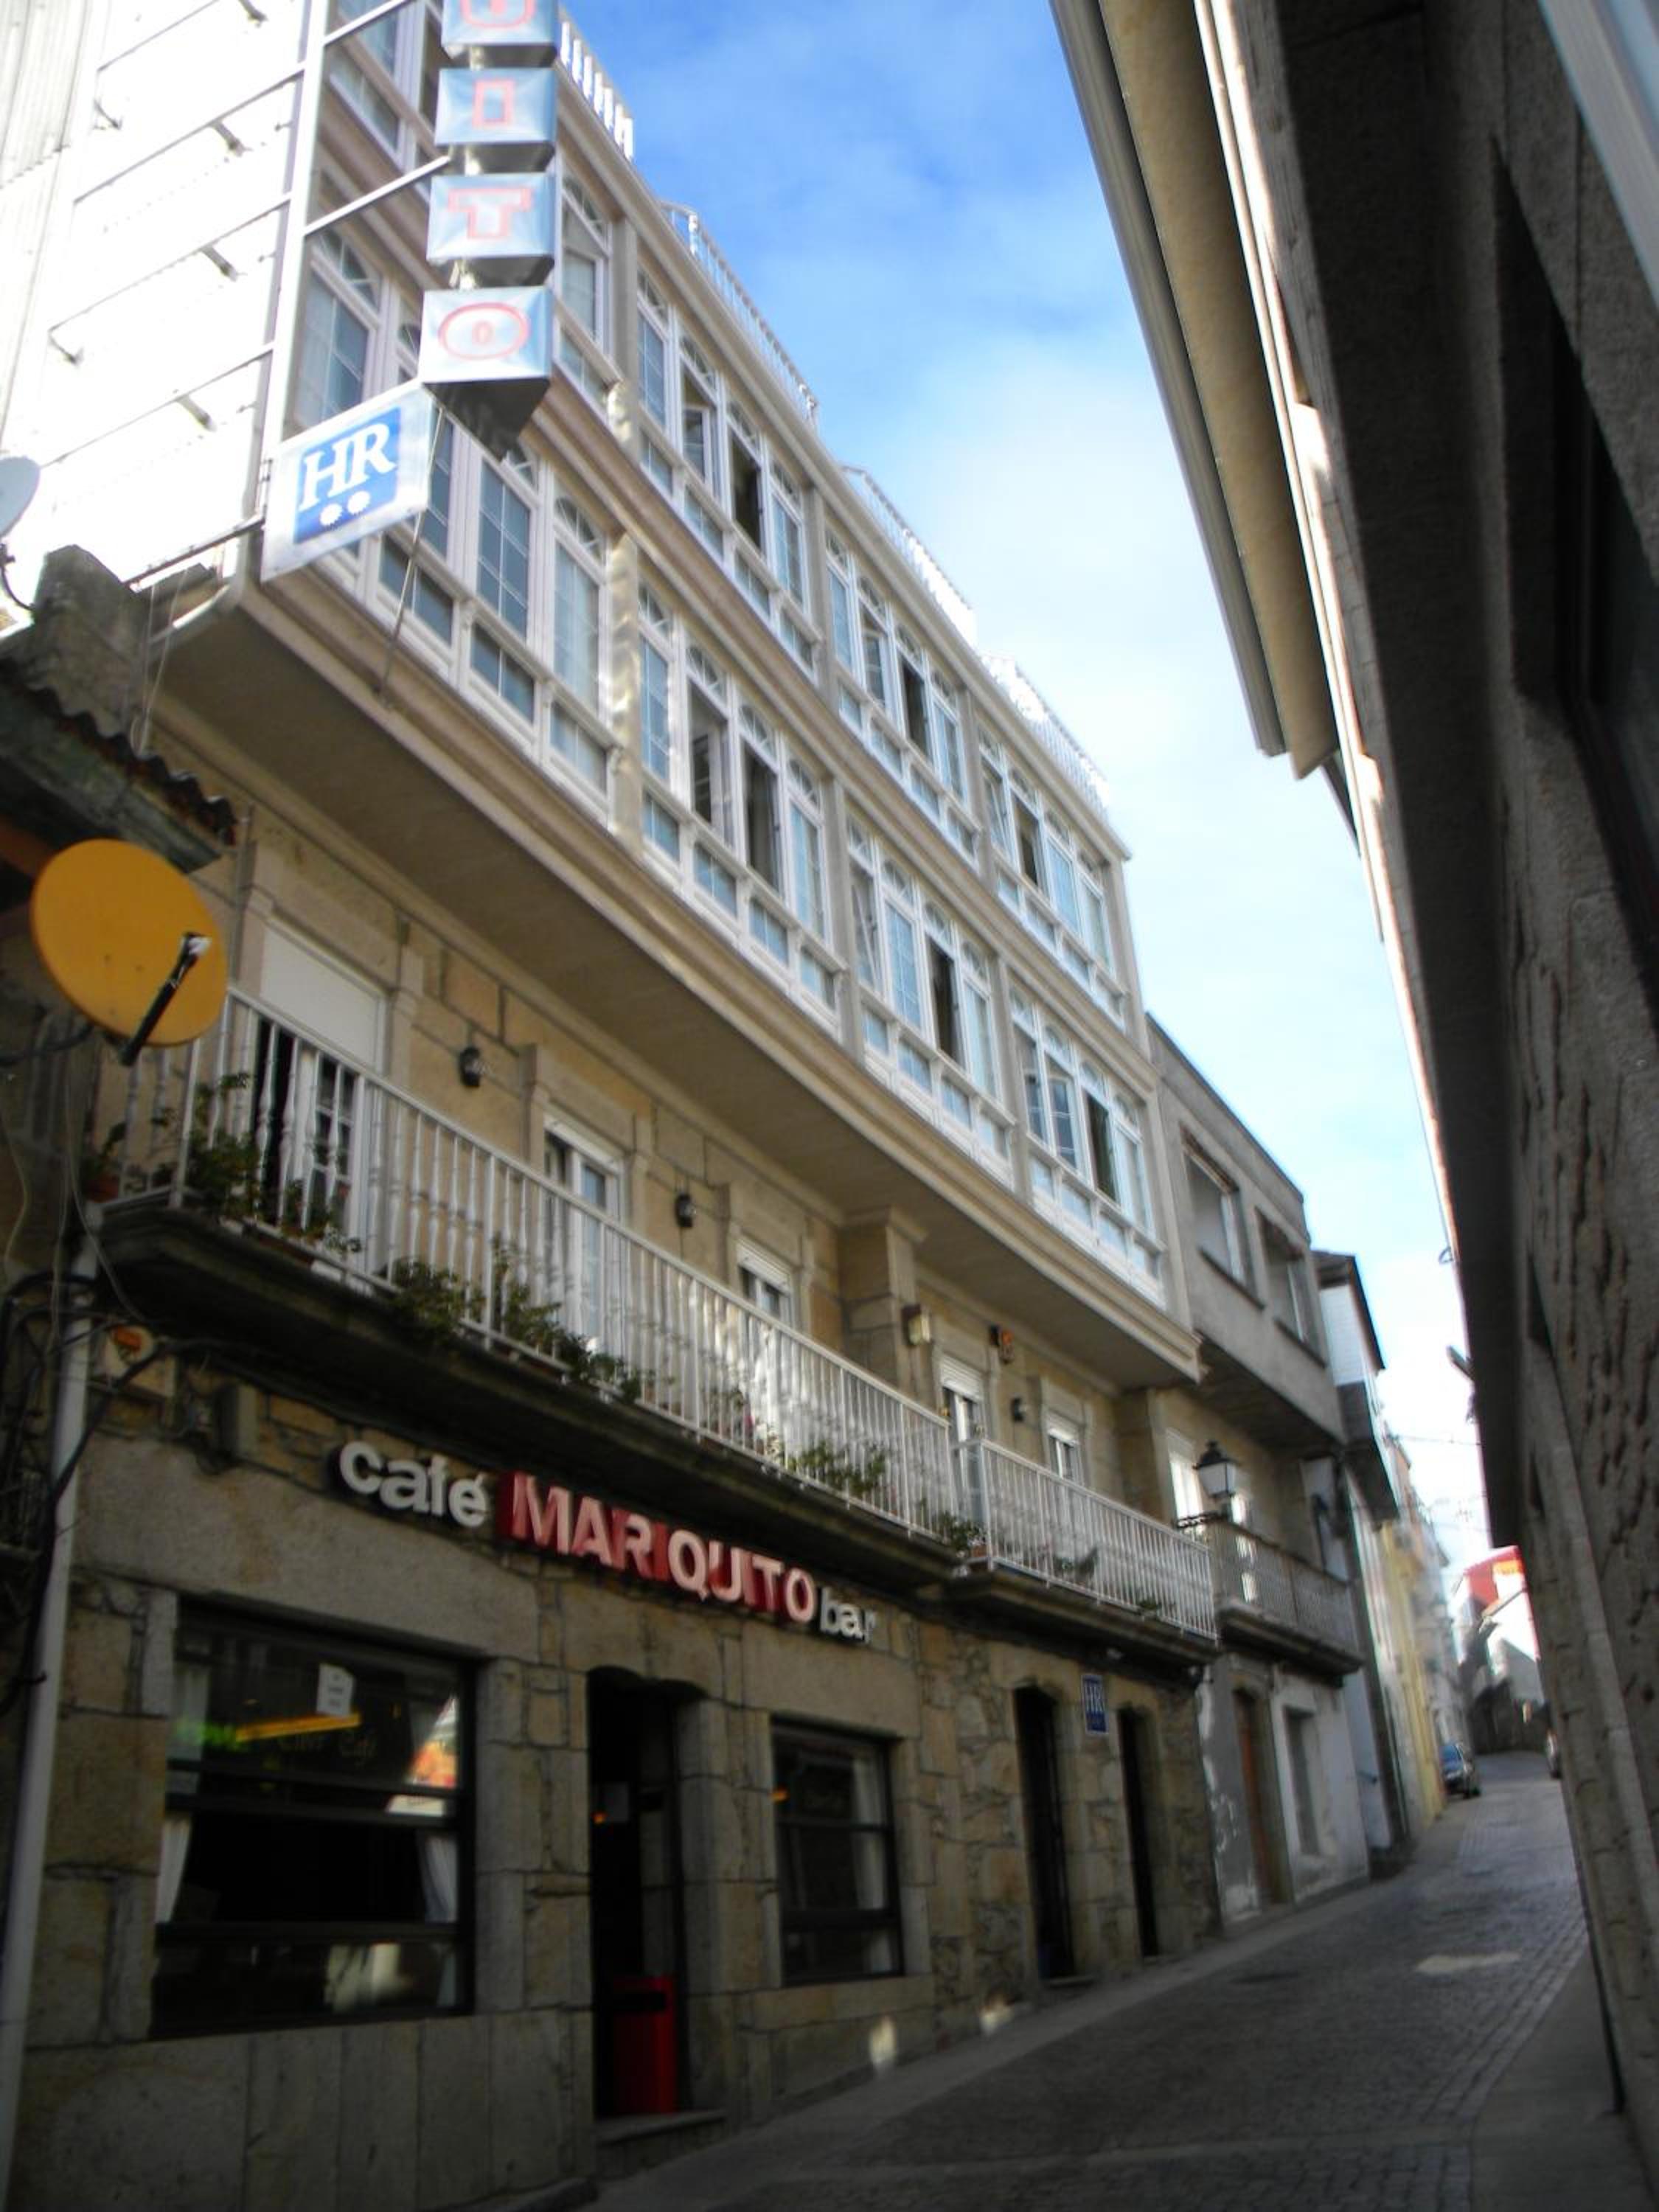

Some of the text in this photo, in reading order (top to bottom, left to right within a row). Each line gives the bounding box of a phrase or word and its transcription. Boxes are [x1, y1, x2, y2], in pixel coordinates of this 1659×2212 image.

[299, 422, 398, 510] HR
[503, 1470, 816, 1624] MARQUITO
[820, 1585, 876, 1645] bar
